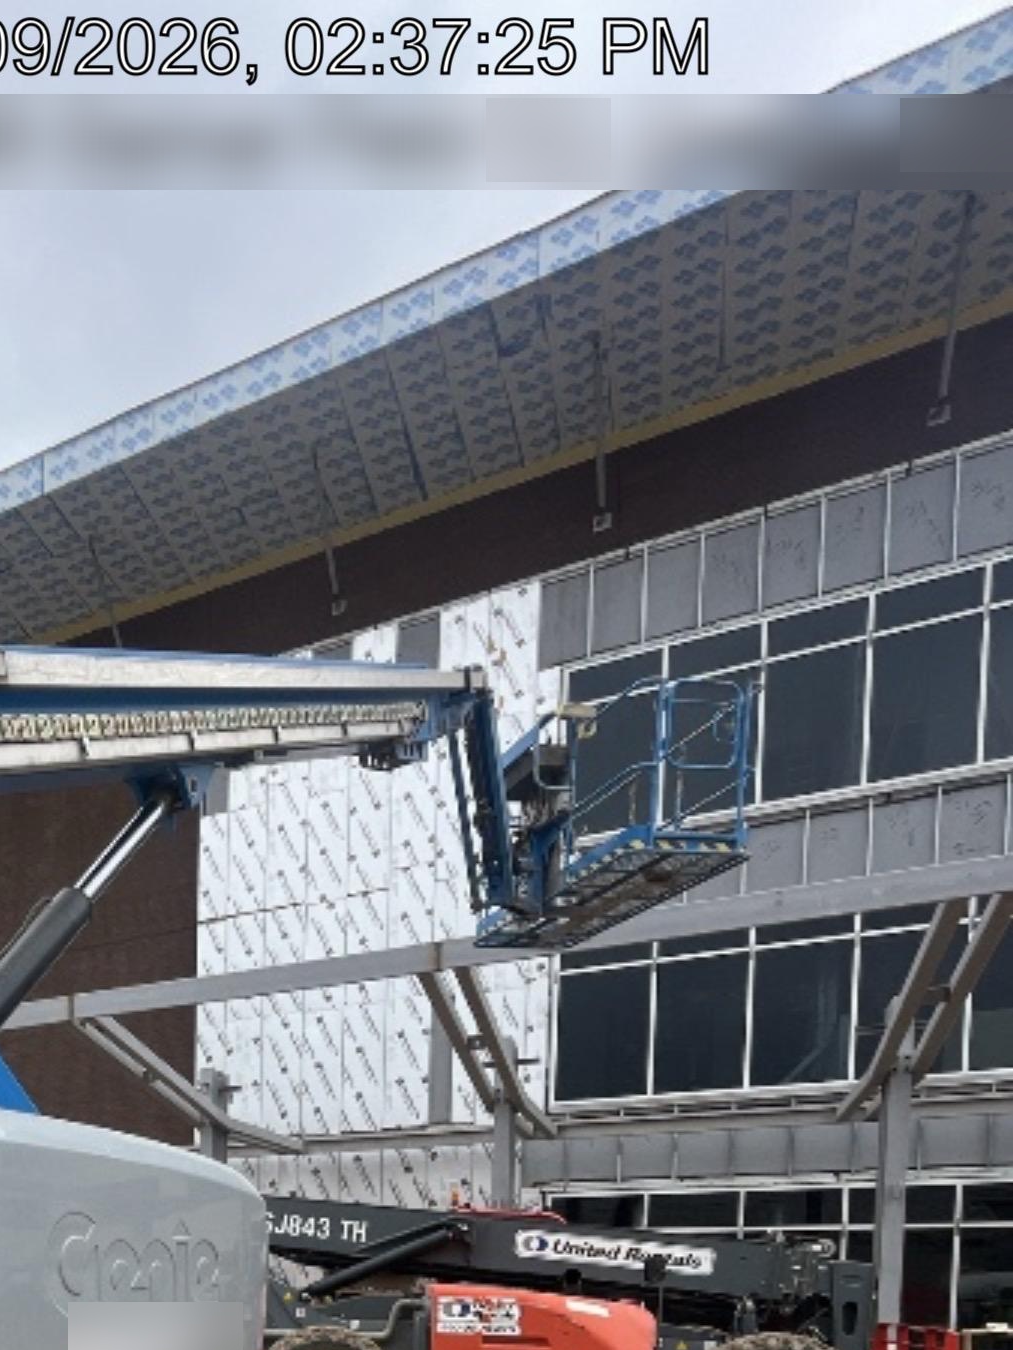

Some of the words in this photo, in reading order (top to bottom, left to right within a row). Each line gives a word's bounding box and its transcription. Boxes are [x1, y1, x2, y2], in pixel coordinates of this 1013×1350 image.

[340, 1219, 368, 1243] TH
[553, 1238, 620, 1261] United
[47, 1211, 224, 1319] Genie
